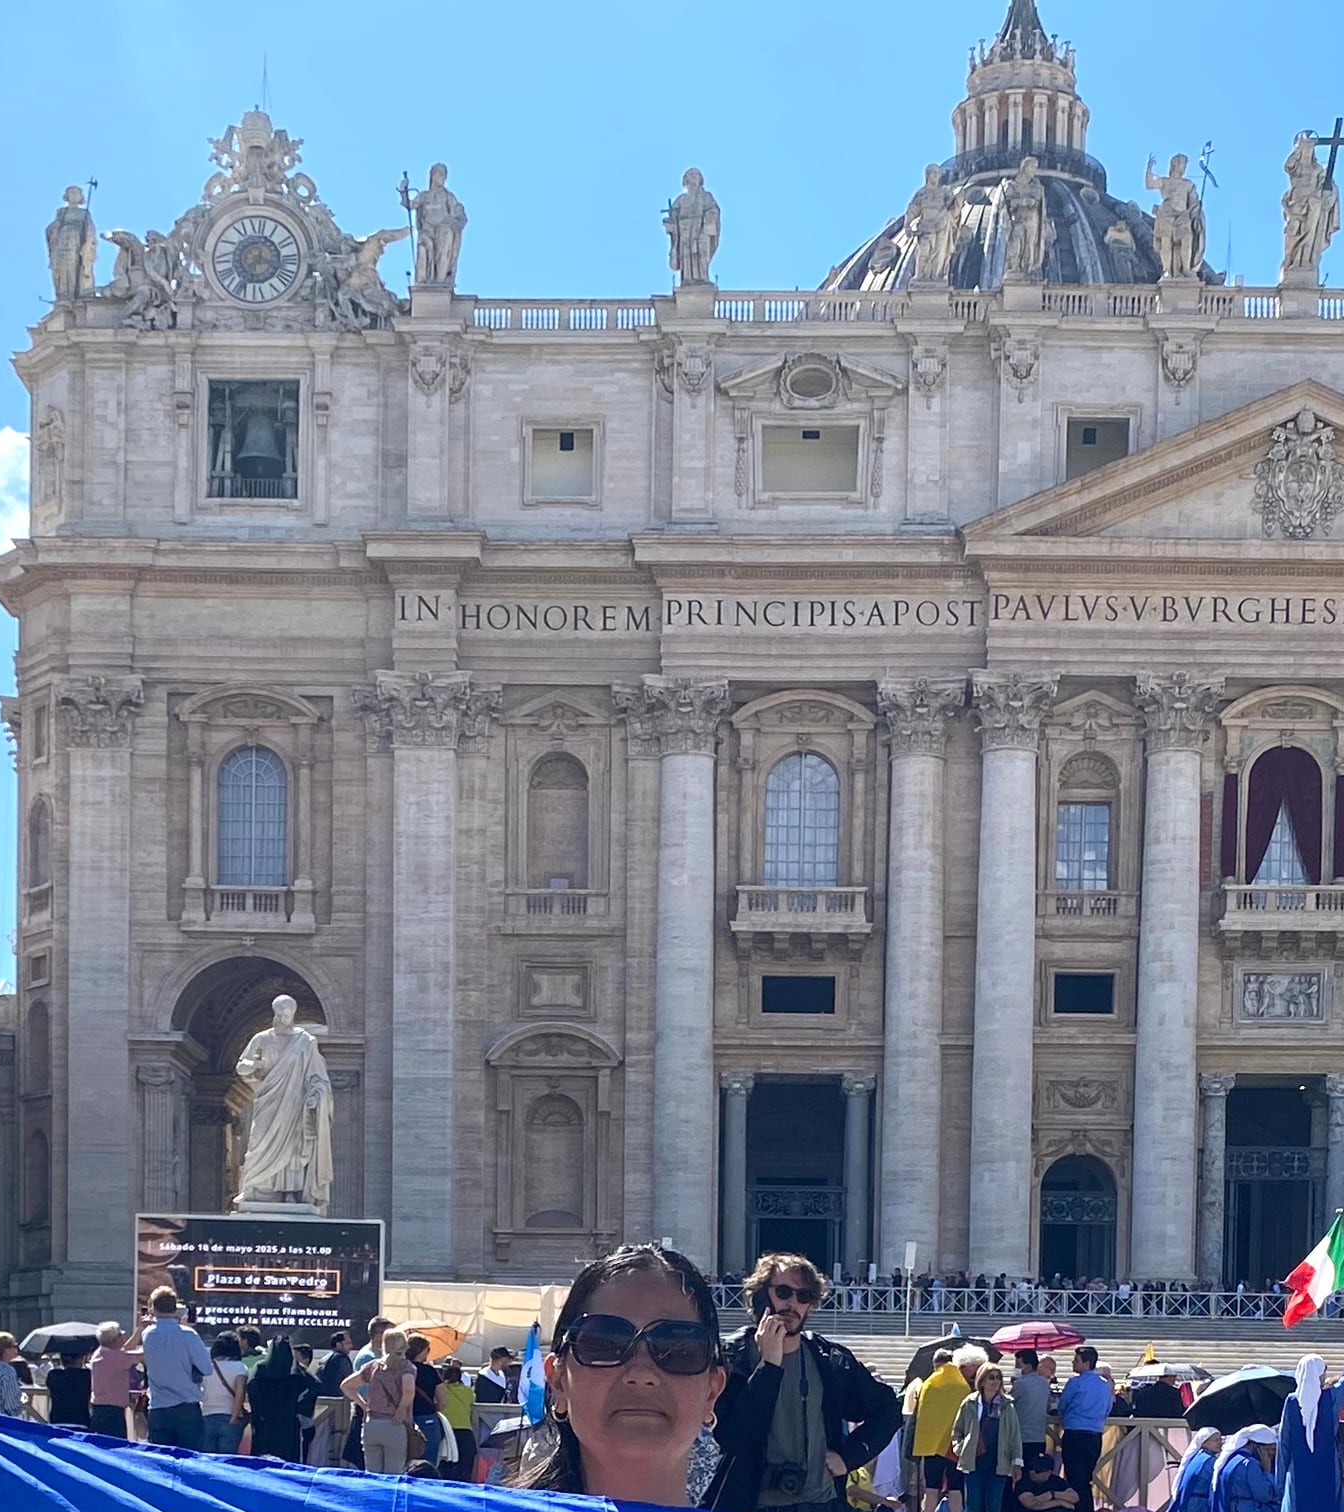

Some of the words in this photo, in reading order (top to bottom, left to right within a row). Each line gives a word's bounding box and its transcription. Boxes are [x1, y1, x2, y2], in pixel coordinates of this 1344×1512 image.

[399, 595, 441, 621] IN
[459, 604, 652, 632] HONOREM
[666, 600, 856, 626] PRINCIPIS
[866, 599, 983, 626] APOST
[992, 594, 1119, 622] PAVLVS
[1128, 596, 1151, 622] V
[159, 1242, 195, 1252] Sábado
[211, 1243, 224, 1252] de
[225, 1244, 253, 1255] mayo
[255, 1245, 277, 1253] 2025
[288, 1246, 303, 1254] las
[207, 1274, 242, 1285] Plaza
[244, 1275, 260, 1285] de
[264, 1276, 287, 1286] San
[290, 1276, 328, 1288] Pedro
[196, 1306, 203, 1316] y
[205, 1306, 257, 1316] procesión
[232, 1316, 246, 1325] de
[248, 1316, 258, 1325] la
[261, 1317, 296, 1326] MATER
[298, 1318, 351, 1328] ECCLESIAE
